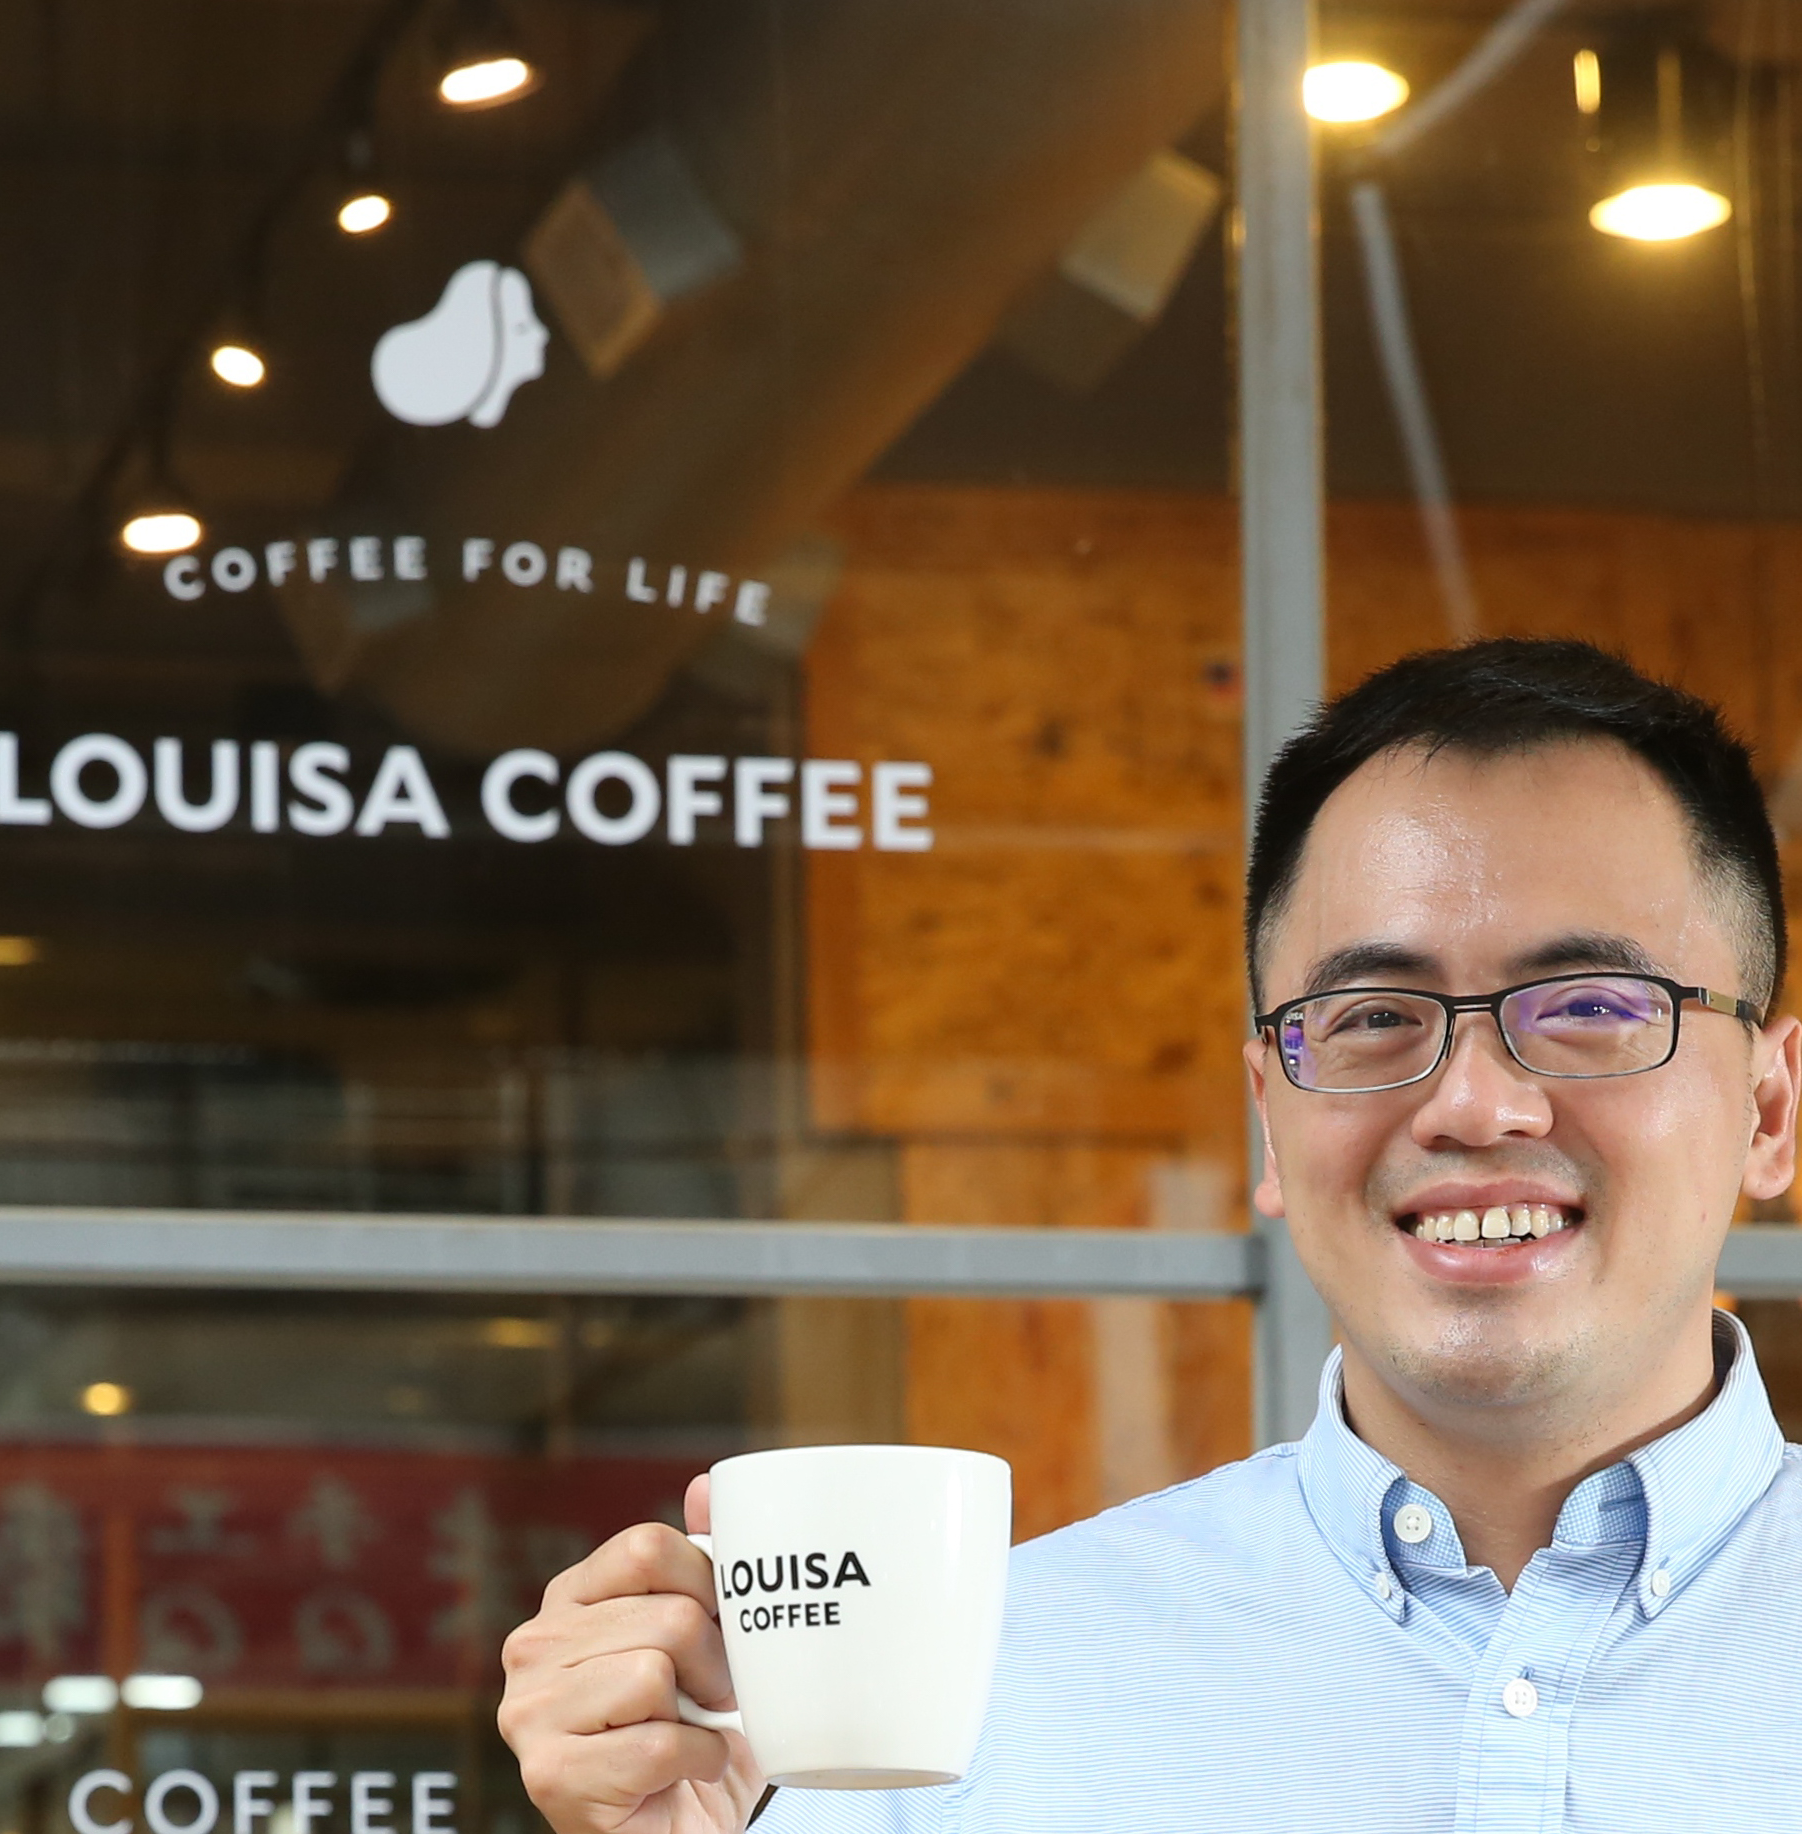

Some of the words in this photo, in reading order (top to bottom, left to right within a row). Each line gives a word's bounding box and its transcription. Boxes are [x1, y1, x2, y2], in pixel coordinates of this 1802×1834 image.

[164, 535, 427, 601] COFFEE
[462, 539, 593, 592] FOR
[625, 556, 771, 626] LIFE
[480, 747, 934, 852] COFFEE
[720, 1551, 871, 1599] LOUISA
[739, 1601, 842, 1633] COFFEE
